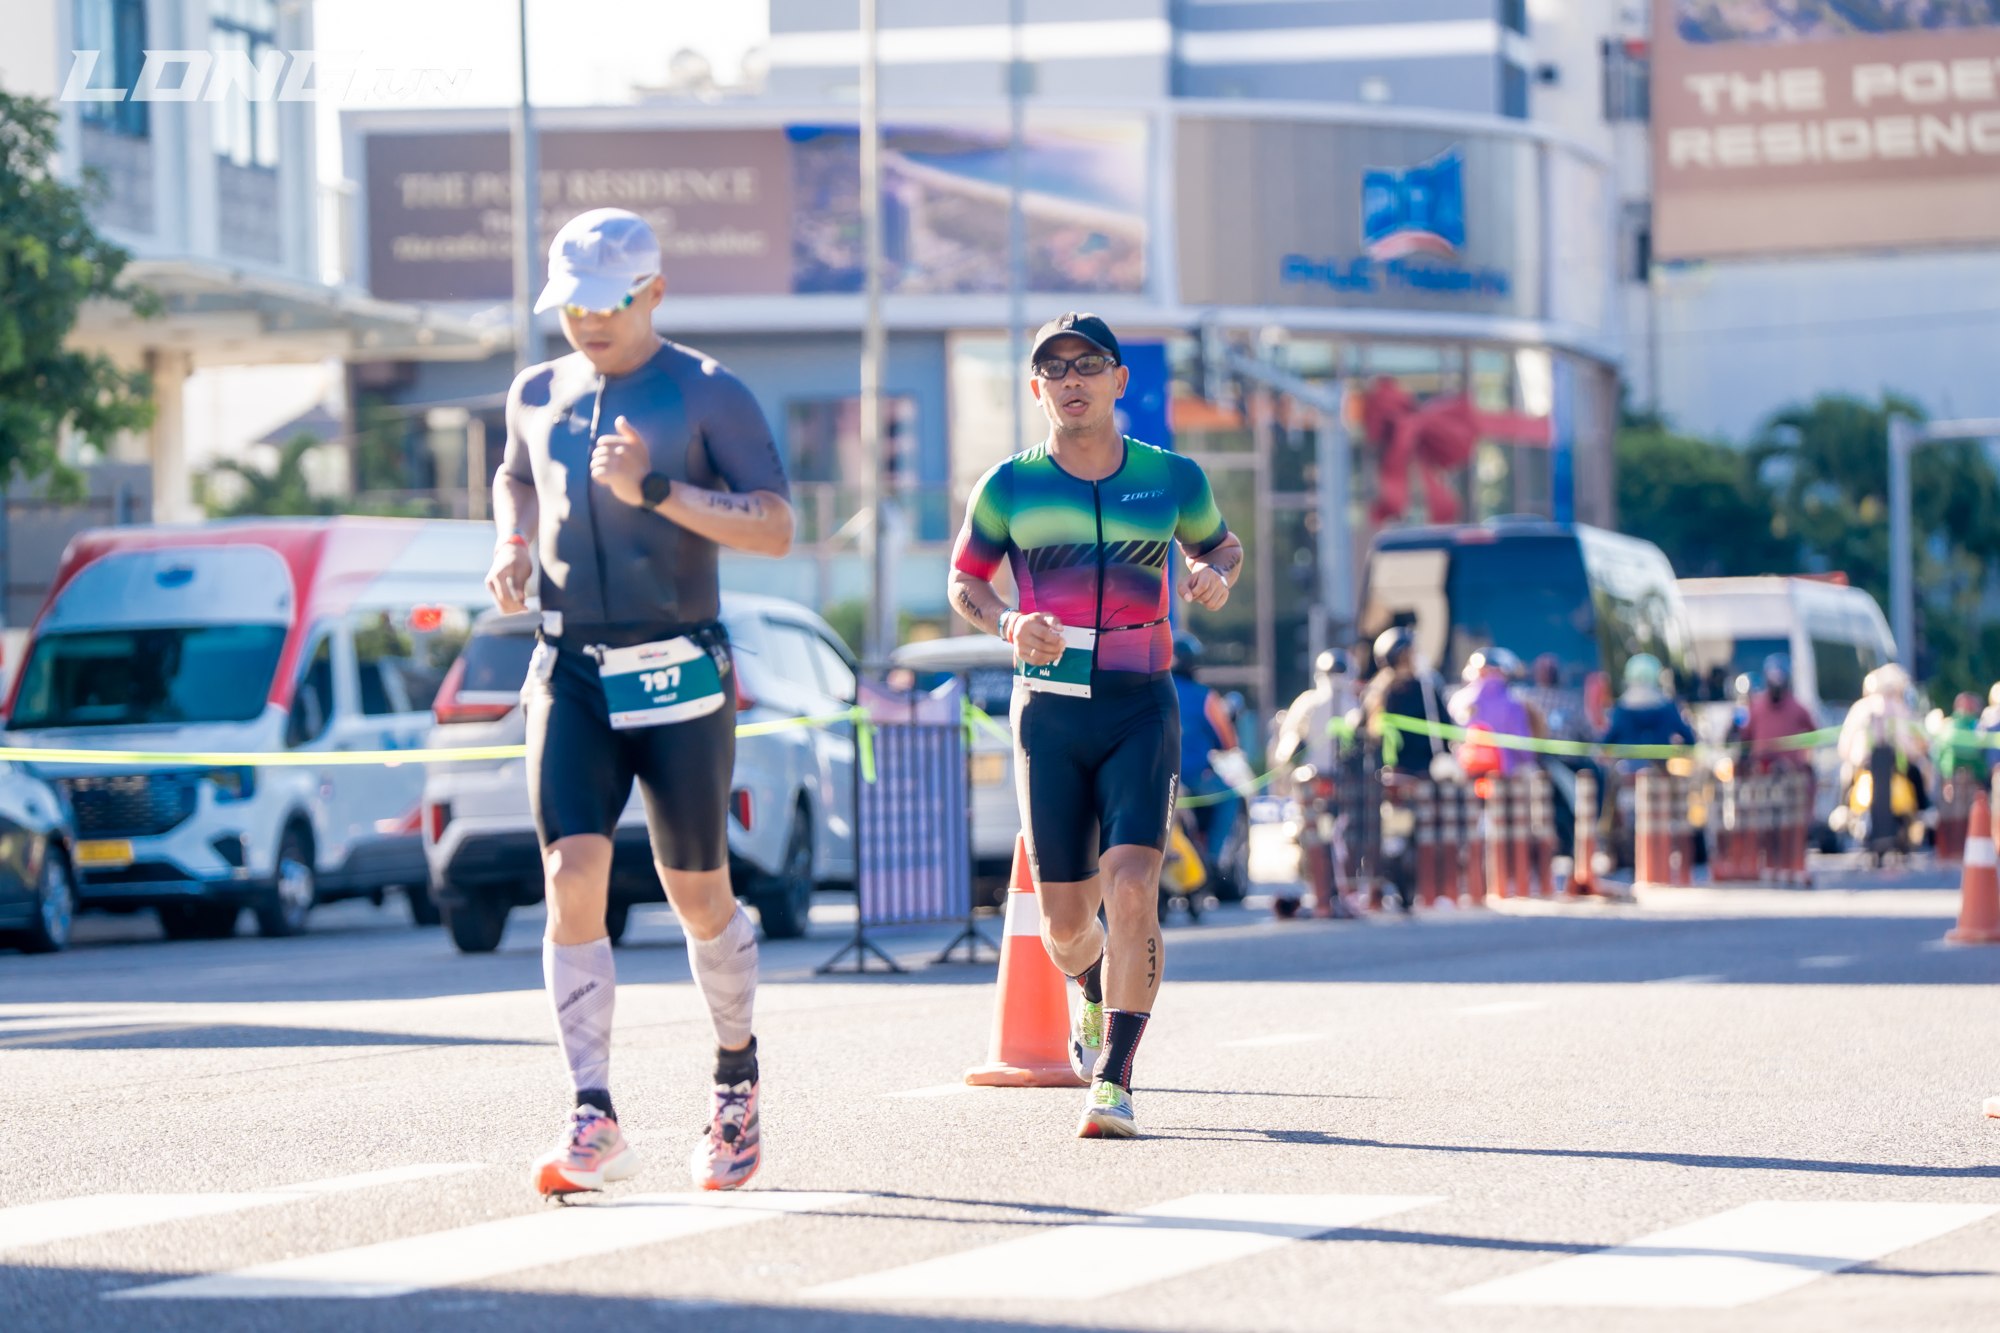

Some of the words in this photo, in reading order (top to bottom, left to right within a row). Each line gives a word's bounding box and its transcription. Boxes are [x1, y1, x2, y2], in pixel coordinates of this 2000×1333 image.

[1683, 67, 1826, 116] THE
[1853, 56, 2000, 108] POE
[638, 666, 681, 692] 797
[1147, 937, 1157, 988] 317
